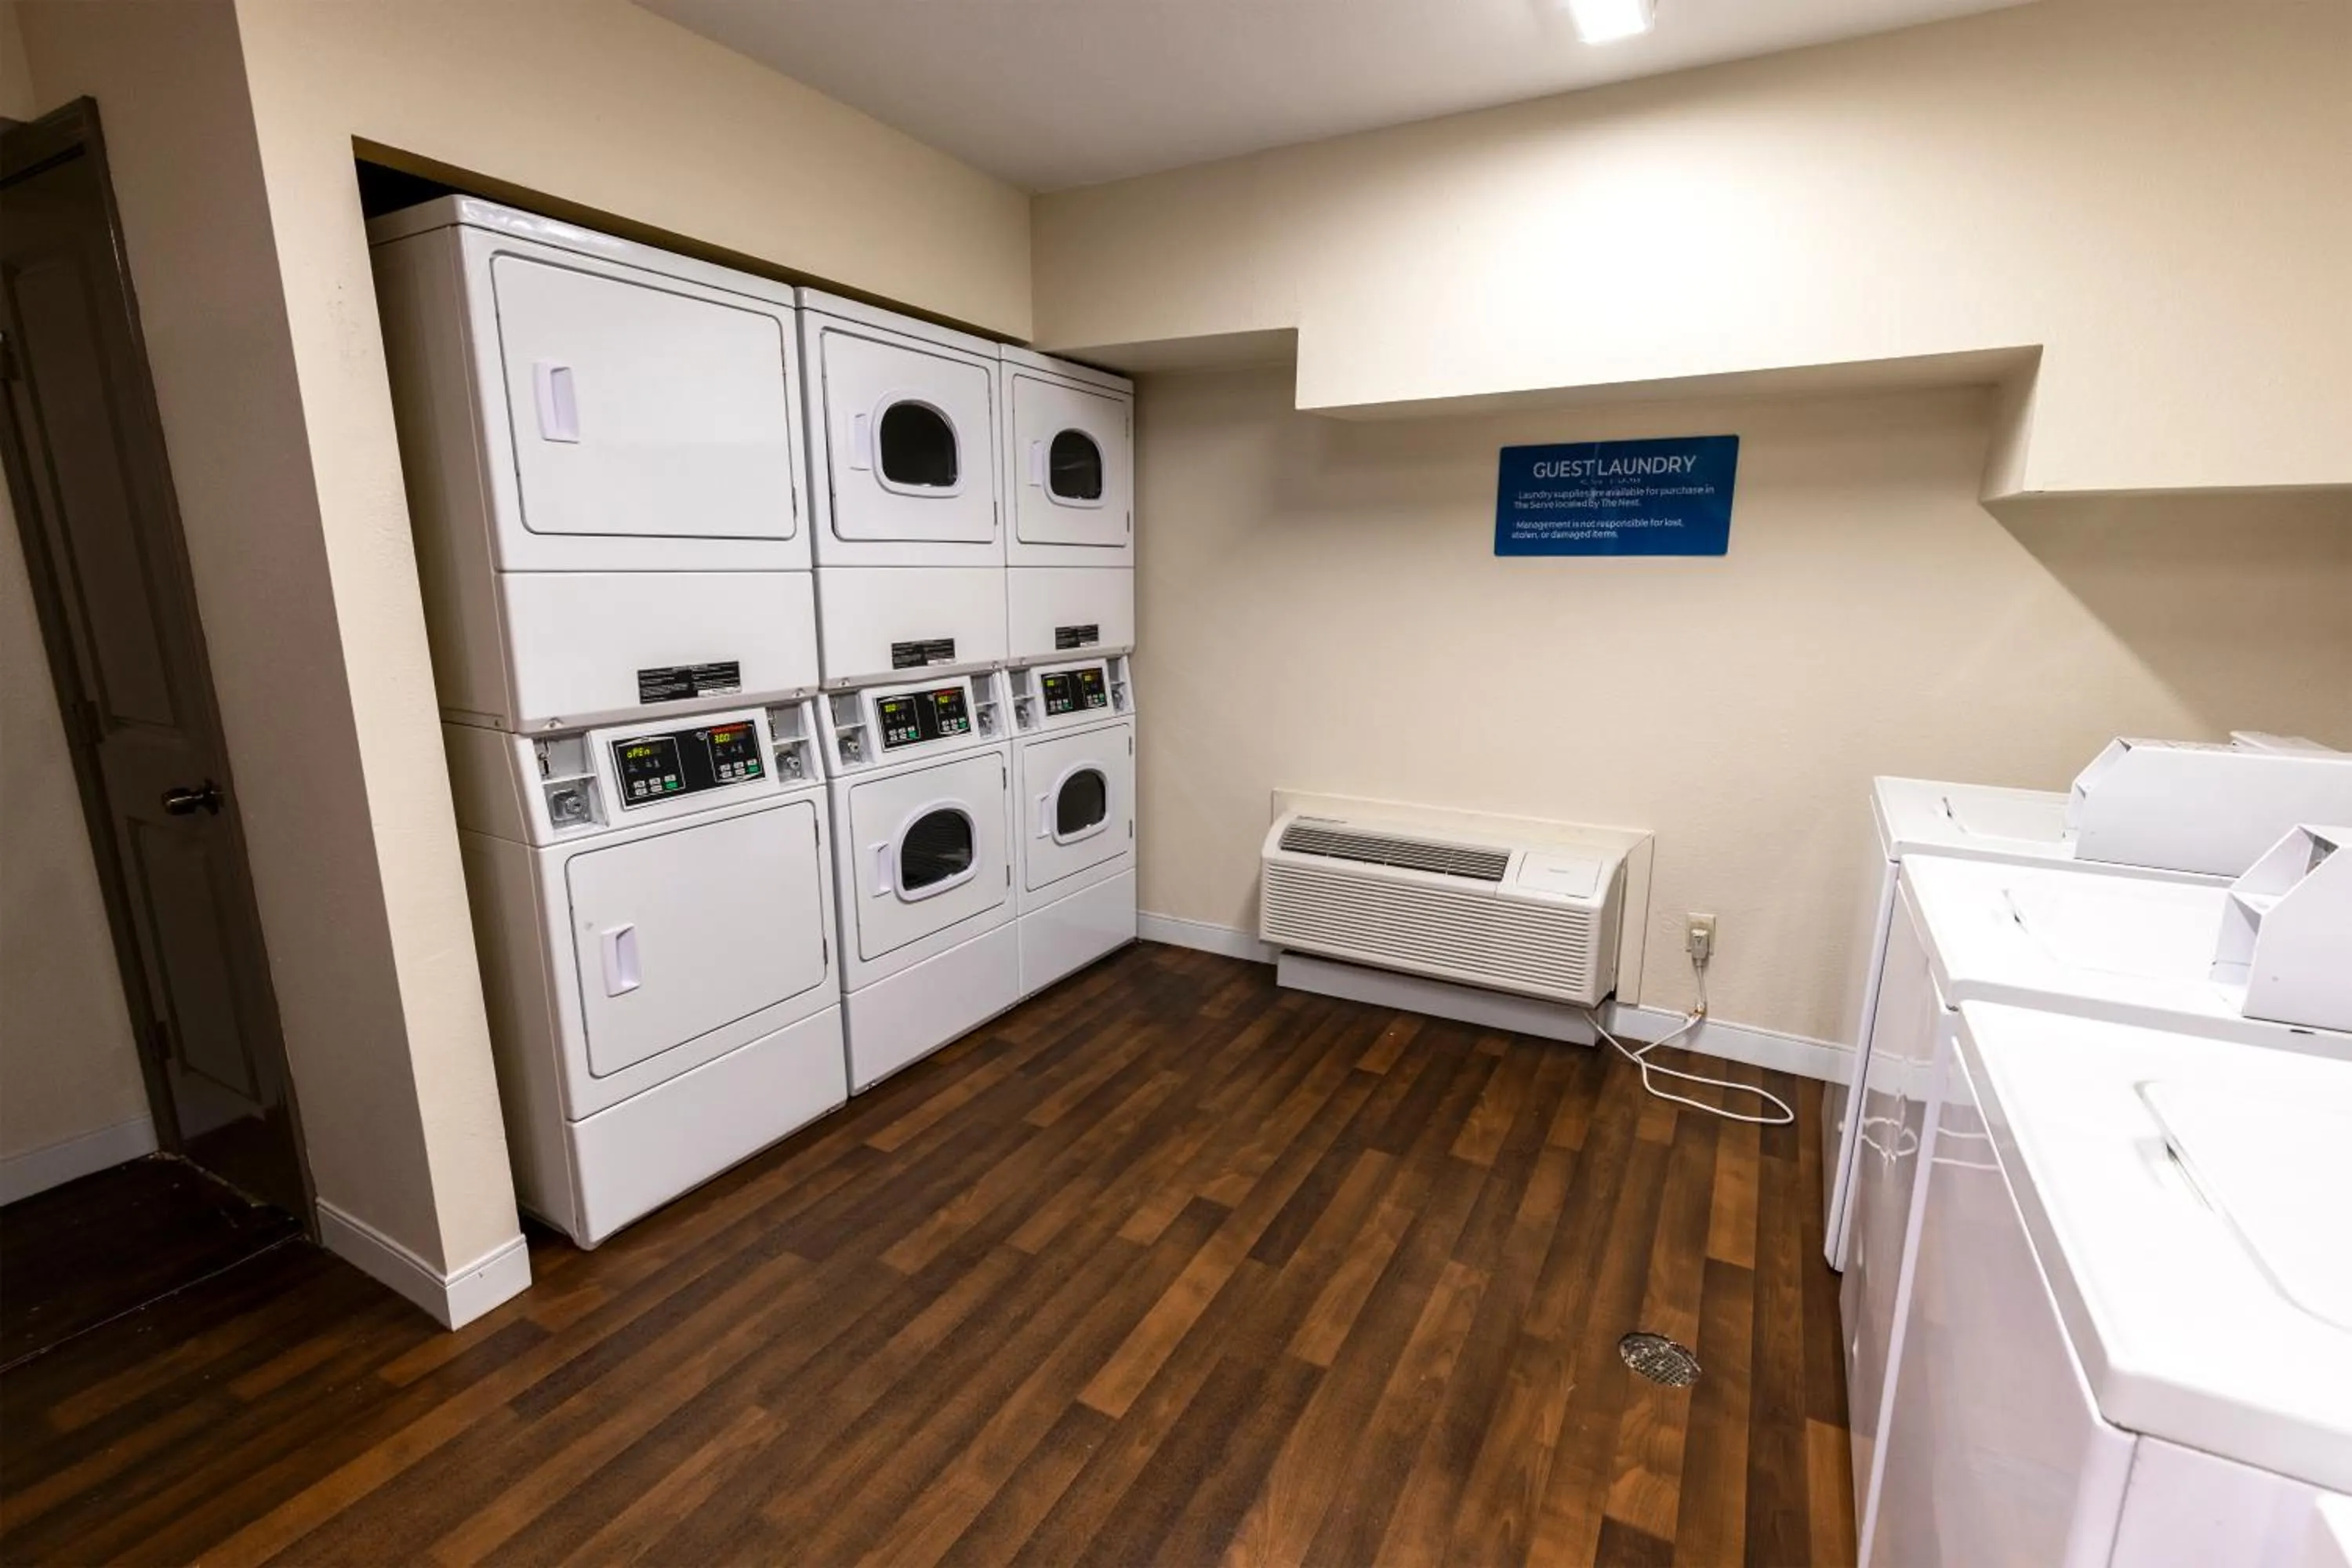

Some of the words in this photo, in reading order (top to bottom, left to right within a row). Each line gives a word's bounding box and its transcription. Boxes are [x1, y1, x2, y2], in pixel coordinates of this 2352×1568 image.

[1533, 459, 1595, 477] GUEST
[1598, 455, 1697, 475] LAUNDRY
[1519, 491, 1552, 500] Laundry
[1553, 489, 1588, 499] supplies
[1605, 487, 1645, 496] available
[1646, 486, 1659, 495] for
[1660, 486, 1704, 497] purchase
[1705, 484, 1715, 493] in
[1555, 499, 1587, 508] located
[1601, 498, 1617, 507] The
[1516, 521, 1570, 530] Management
[1596, 518, 1649, 529] responsible
[1650, 518, 1664, 527] for
[1551, 530, 1591, 540] damaged
